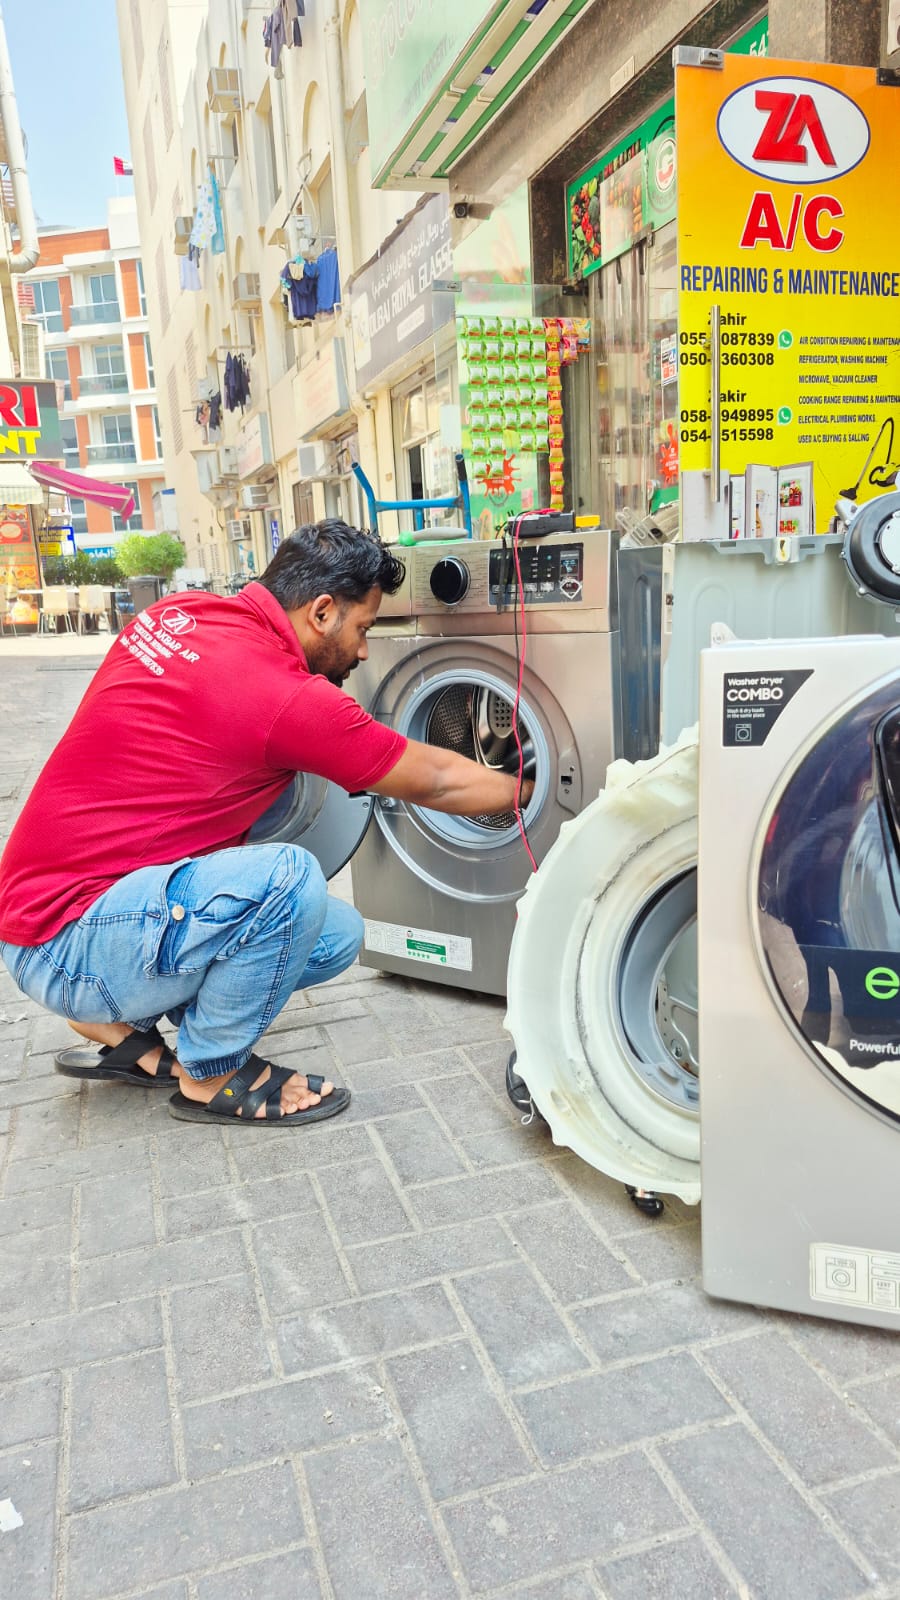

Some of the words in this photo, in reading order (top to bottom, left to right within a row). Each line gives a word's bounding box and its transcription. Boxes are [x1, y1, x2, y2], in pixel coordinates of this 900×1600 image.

[752, 90, 837, 166] ZA
[740, 190, 845, 253] A/C
[681, 265, 768, 293] REPAIRING
[773, 268, 784, 294] &
[788, 268, 900, 297] MAINTENANCE
[368, 304, 391, 339] DUBAI
[391, 275, 418, 318] ROYAL
[708, 312, 747, 326] ahir
[799, 336, 809, 345] AIR
[810, 336, 838, 345] CONDITION
[839, 337, 867, 345] REPAIRING
[867, 337, 872, 345] &
[679, 352, 775, 366] 050-360308
[840, 355, 864, 364] WASHING
[864, 356, 888, 364] MACHINE
[854, 375, 878, 383] CLEANER
[708, 390, 747, 402] akir
[798, 396, 823, 404] COOKING
[823, 396, 841, 404] RANGE
[842, 395, 868, 404] REPAIRING
[869, 395, 874, 403] &
[680, 408, 774, 422] 058-949895
[798, 415, 829, 424] ELECTRICAL
[830, 414, 857, 423] PLUMBING
[857, 414, 876, 422] WORKS
[680, 428, 774, 442] 054-515598
[797, 435, 812, 443] USED
[822, 434, 842, 443] BUYING
[843, 434, 847, 442] &
[153, 628, 182, 652] AKBAR
[178, 648, 201, 663] AIR
[727, 678, 760, 687] Washer
[760, 677, 785, 687] Dryer
[726, 687, 784, 702] COMBO
